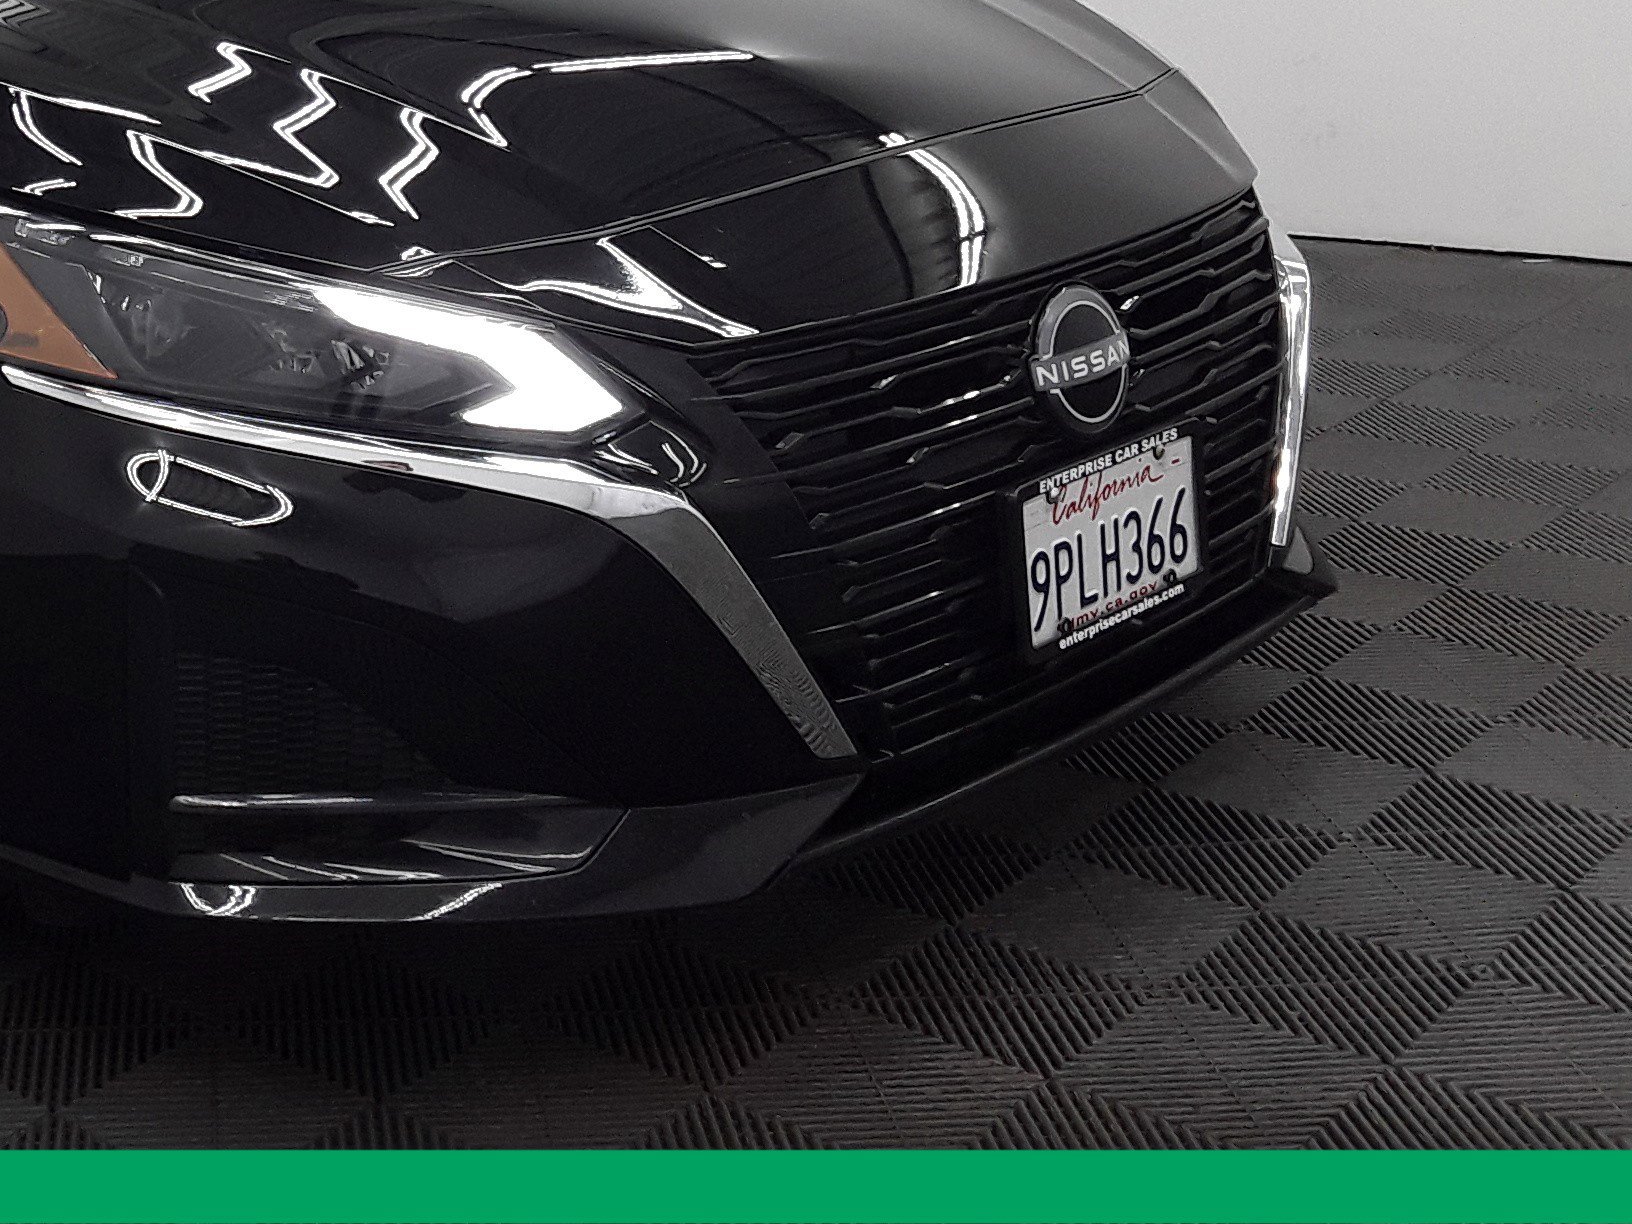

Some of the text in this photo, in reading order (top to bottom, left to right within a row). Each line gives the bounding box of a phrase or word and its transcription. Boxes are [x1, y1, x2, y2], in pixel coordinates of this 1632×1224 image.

[1035, 339, 1130, 387] NISSAN
[1039, 427, 1179, 494] ENTERPRISE CAR SALES
[1052, 461, 1164, 525] California
[1030, 486, 1189, 633] 9PLH366
[1058, 582, 1186, 650] enterprisecarsales.com
